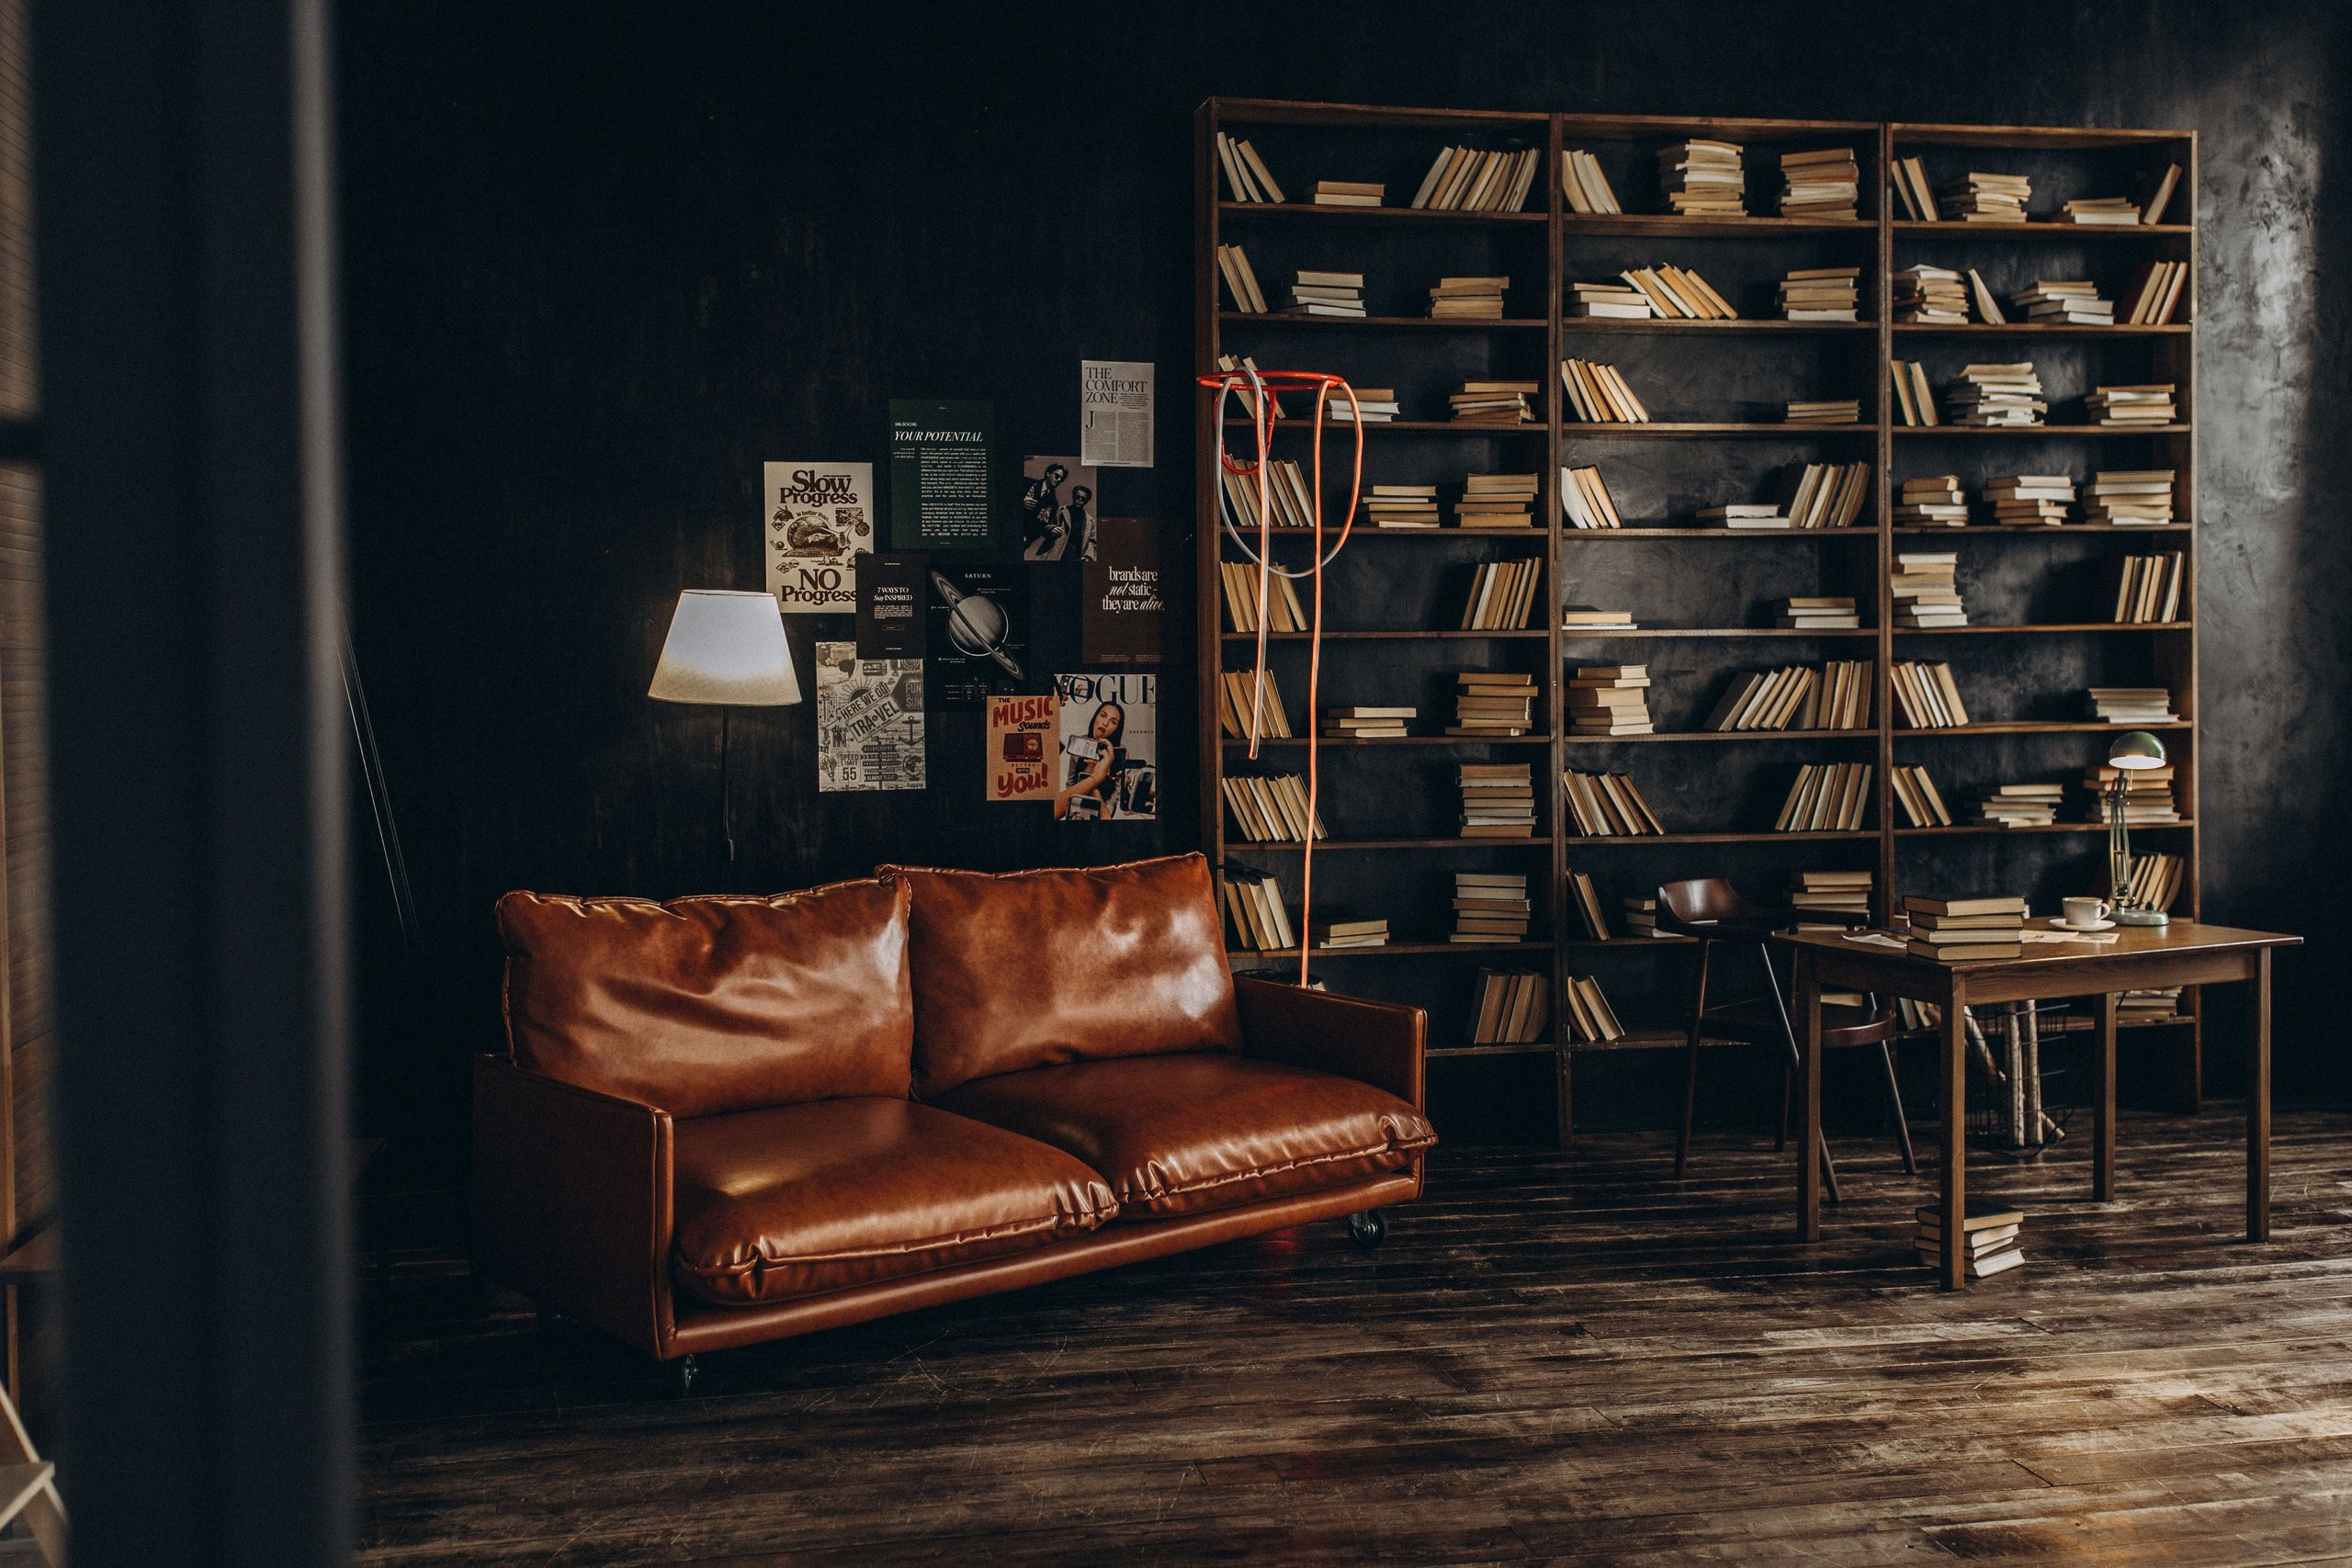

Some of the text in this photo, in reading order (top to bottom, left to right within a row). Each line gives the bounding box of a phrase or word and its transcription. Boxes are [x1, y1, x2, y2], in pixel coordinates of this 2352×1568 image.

[1085, 367, 1112, 379] THE
[1085, 379, 1148, 392] COMFORT
[1085, 392, 1118, 404] ZONE
[895, 431, 983, 442] YOUR POTENTIAL
[791, 469, 852, 493] Slow
[780, 487, 858, 508] Progress
[798, 569, 842, 591] NO
[1109, 566, 1159, 581] brands are
[1108, 581, 1129, 596] not
[1128, 581, 1152, 596] static
[873, 594, 884, 603] Stay
[1102, 594, 1123, 614] they
[1123, 599, 1139, 611] are
[905, 682, 922, 694] FUN
[840, 701, 863, 720] HERE
[862, 692, 876, 707] WE
[906, 697, 922, 708] SUN
[992, 695, 1054, 728] MUSIC
[831, 725, 849, 733] dive
[1017, 719, 1051, 732] Sounds
[842, 767, 857, 781] 55
